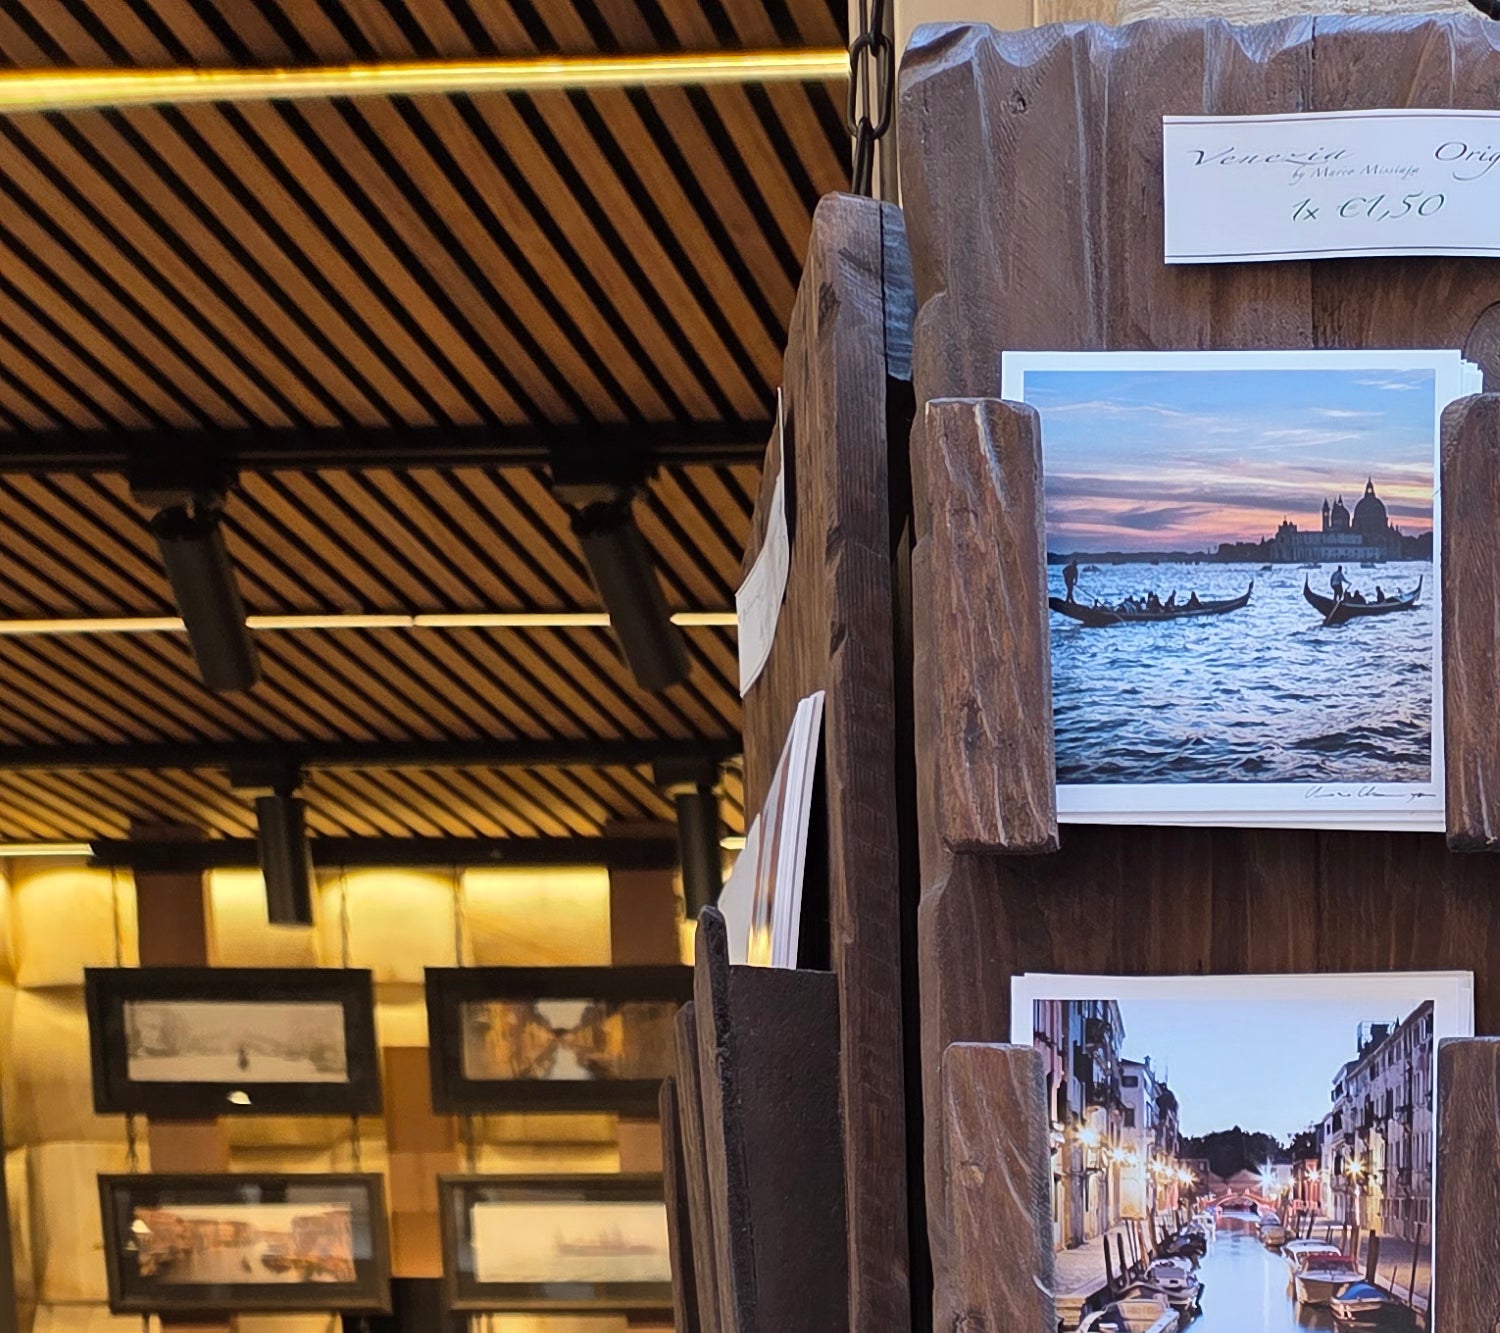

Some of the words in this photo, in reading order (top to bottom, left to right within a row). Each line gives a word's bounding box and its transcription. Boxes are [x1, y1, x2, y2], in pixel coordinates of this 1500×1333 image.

[1190, 146, 1350, 166] Venezia
[1310, 165, 1355, 178] Marco
[1292, 197, 1320, 221] 1x
[1336, 190, 1445, 222] €1,50
